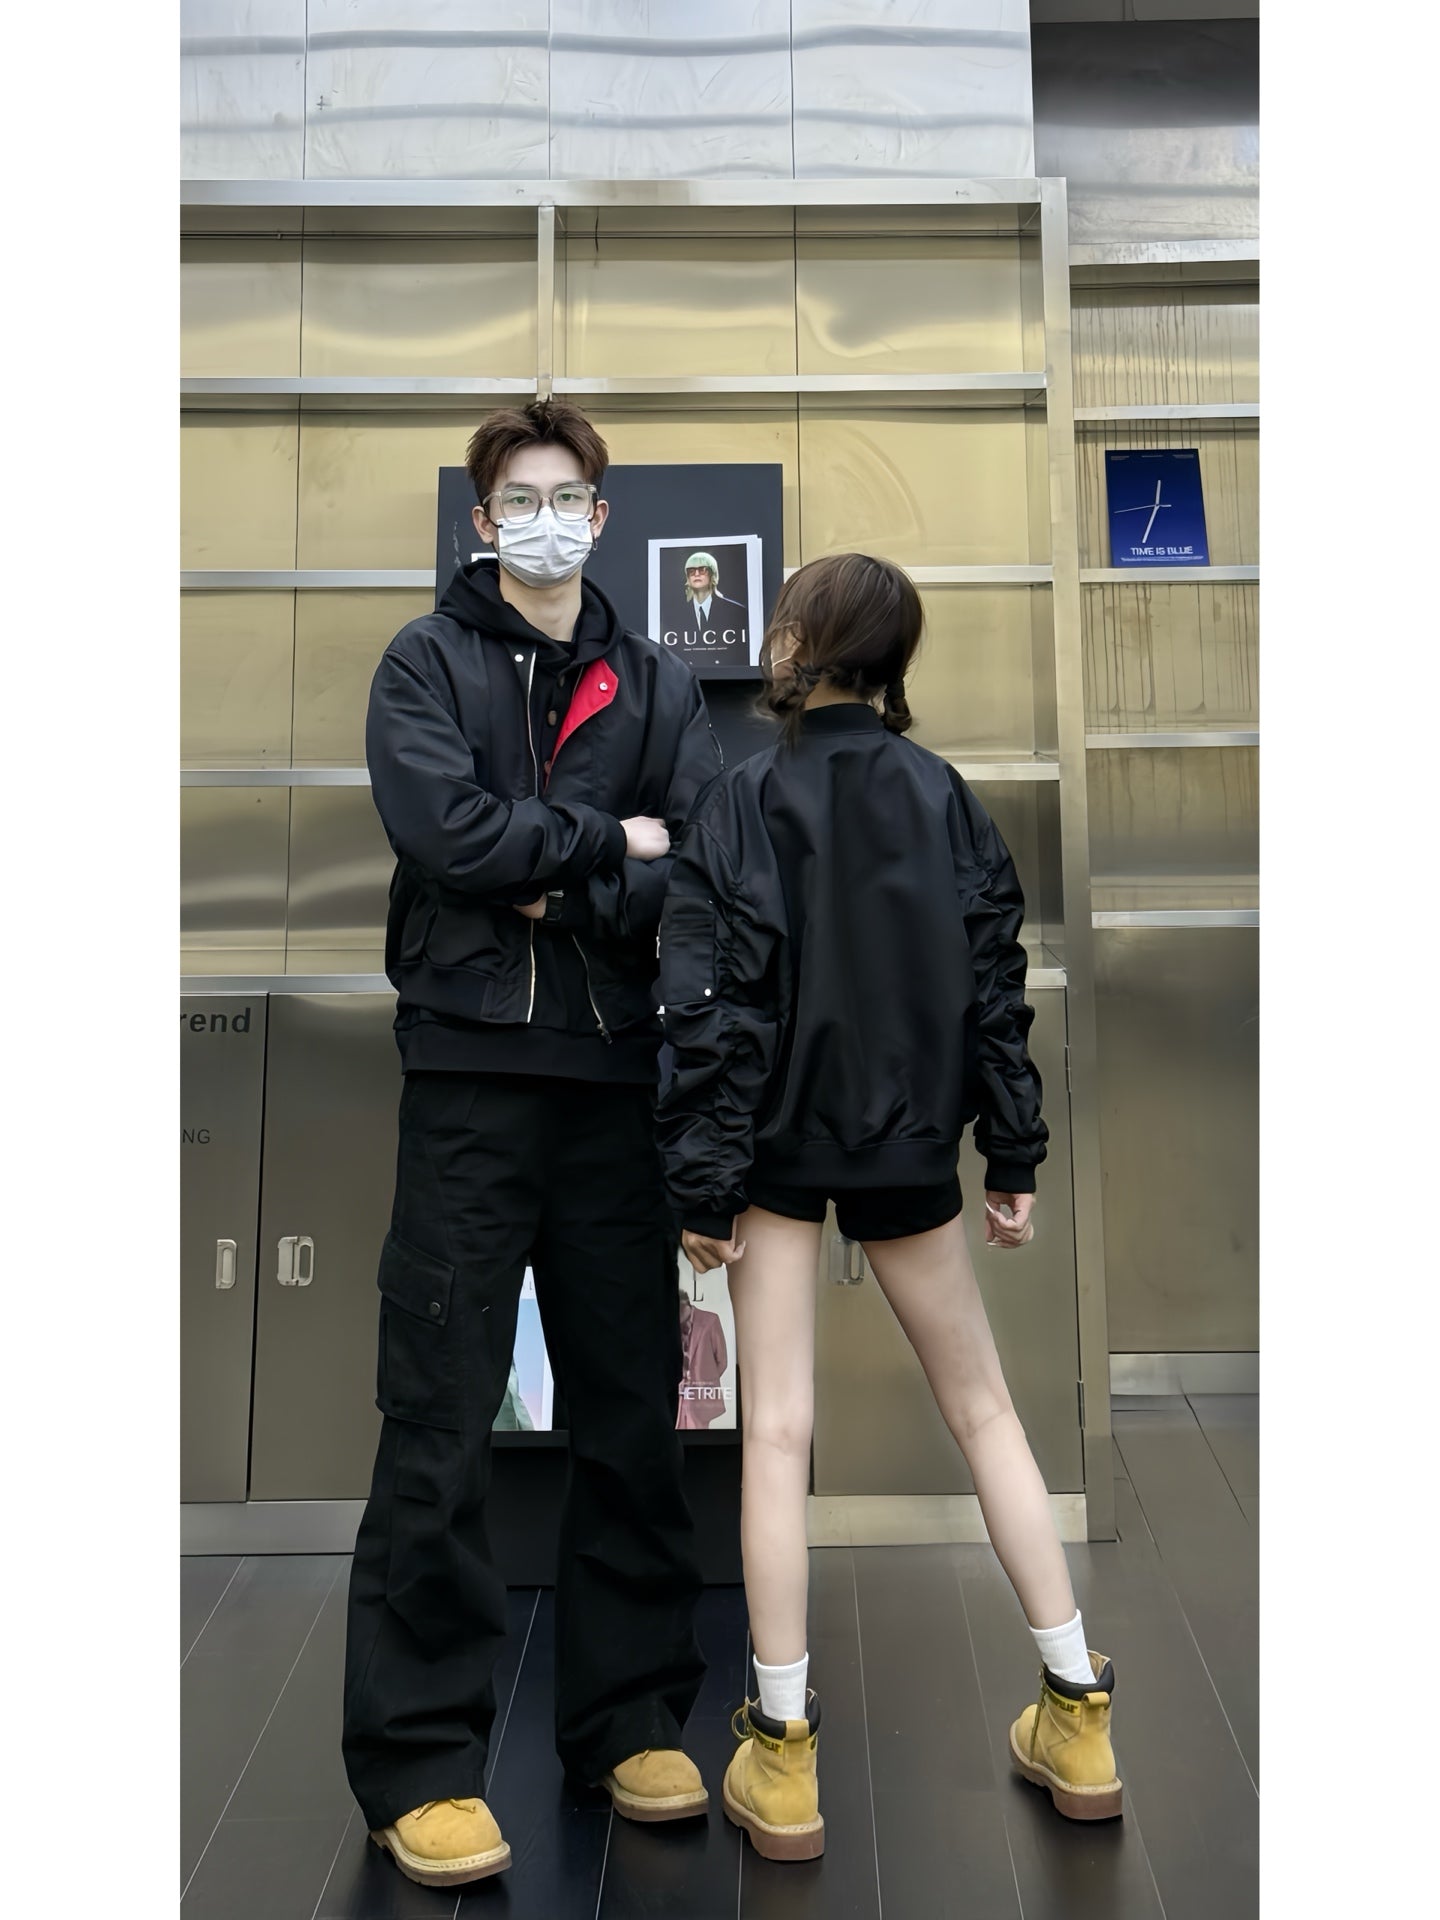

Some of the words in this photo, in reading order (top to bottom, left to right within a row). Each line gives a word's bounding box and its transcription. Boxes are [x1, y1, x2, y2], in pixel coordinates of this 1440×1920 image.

[1130, 547, 1155, 556] TIME
[1155, 547, 1166, 556] IS
[1167, 546, 1194, 556] BLUE
[663, 629, 746, 646] GUCCI
